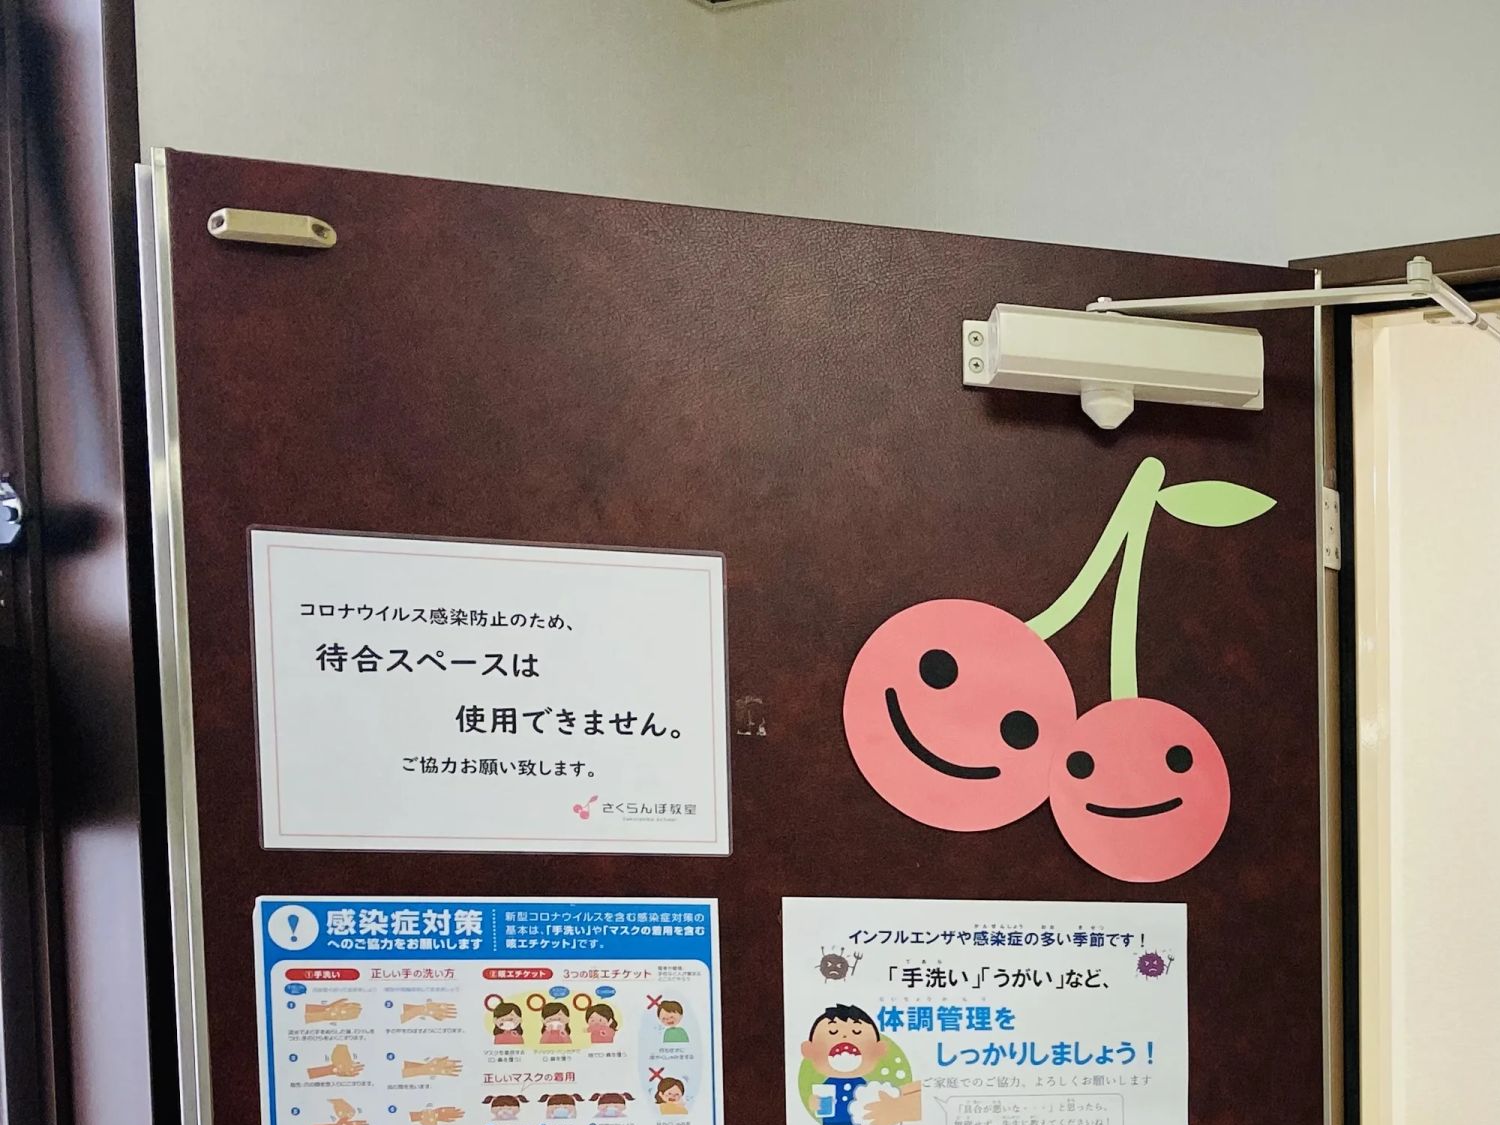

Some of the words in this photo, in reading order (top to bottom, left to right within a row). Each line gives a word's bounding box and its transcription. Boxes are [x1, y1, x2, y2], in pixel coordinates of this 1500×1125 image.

[300, 603, 574, 631] コロナウイルス感染防止のため、
[316, 643, 540, 678] 待合スペースは
[456, 705, 682, 740] 使用できません。
[402, 757, 595, 779] ご協力お願い致します。
[602, 803, 697, 815] さくらんぼ教室
[326, 908, 484, 936] 感染症対策
[505, 911, 705, 922] 新型コロナウイルスを含む感染症対策の
[505, 925, 705, 936] 基本は、「手洗い」や「マスクの着用を含む
[849, 929, 1145, 948] インフルエンザや感染症の多い季節です！
[328, 938, 483, 950] へのご協力をお願いします
[505, 938, 604, 950] 咳エチケット」です。
[371, 968, 455, 979] 正しい手の洗い方
[563, 969, 652, 979] 3つの咳エチケット
[889, 966, 1109, 989] 「手洗い」「うがい」など、
[877, 1005, 1016, 1032] 体調管理を
[936, 1041, 1155, 1067] しっかりしましょう！
[483, 1072, 576, 1084] 正しいマスクの着用
